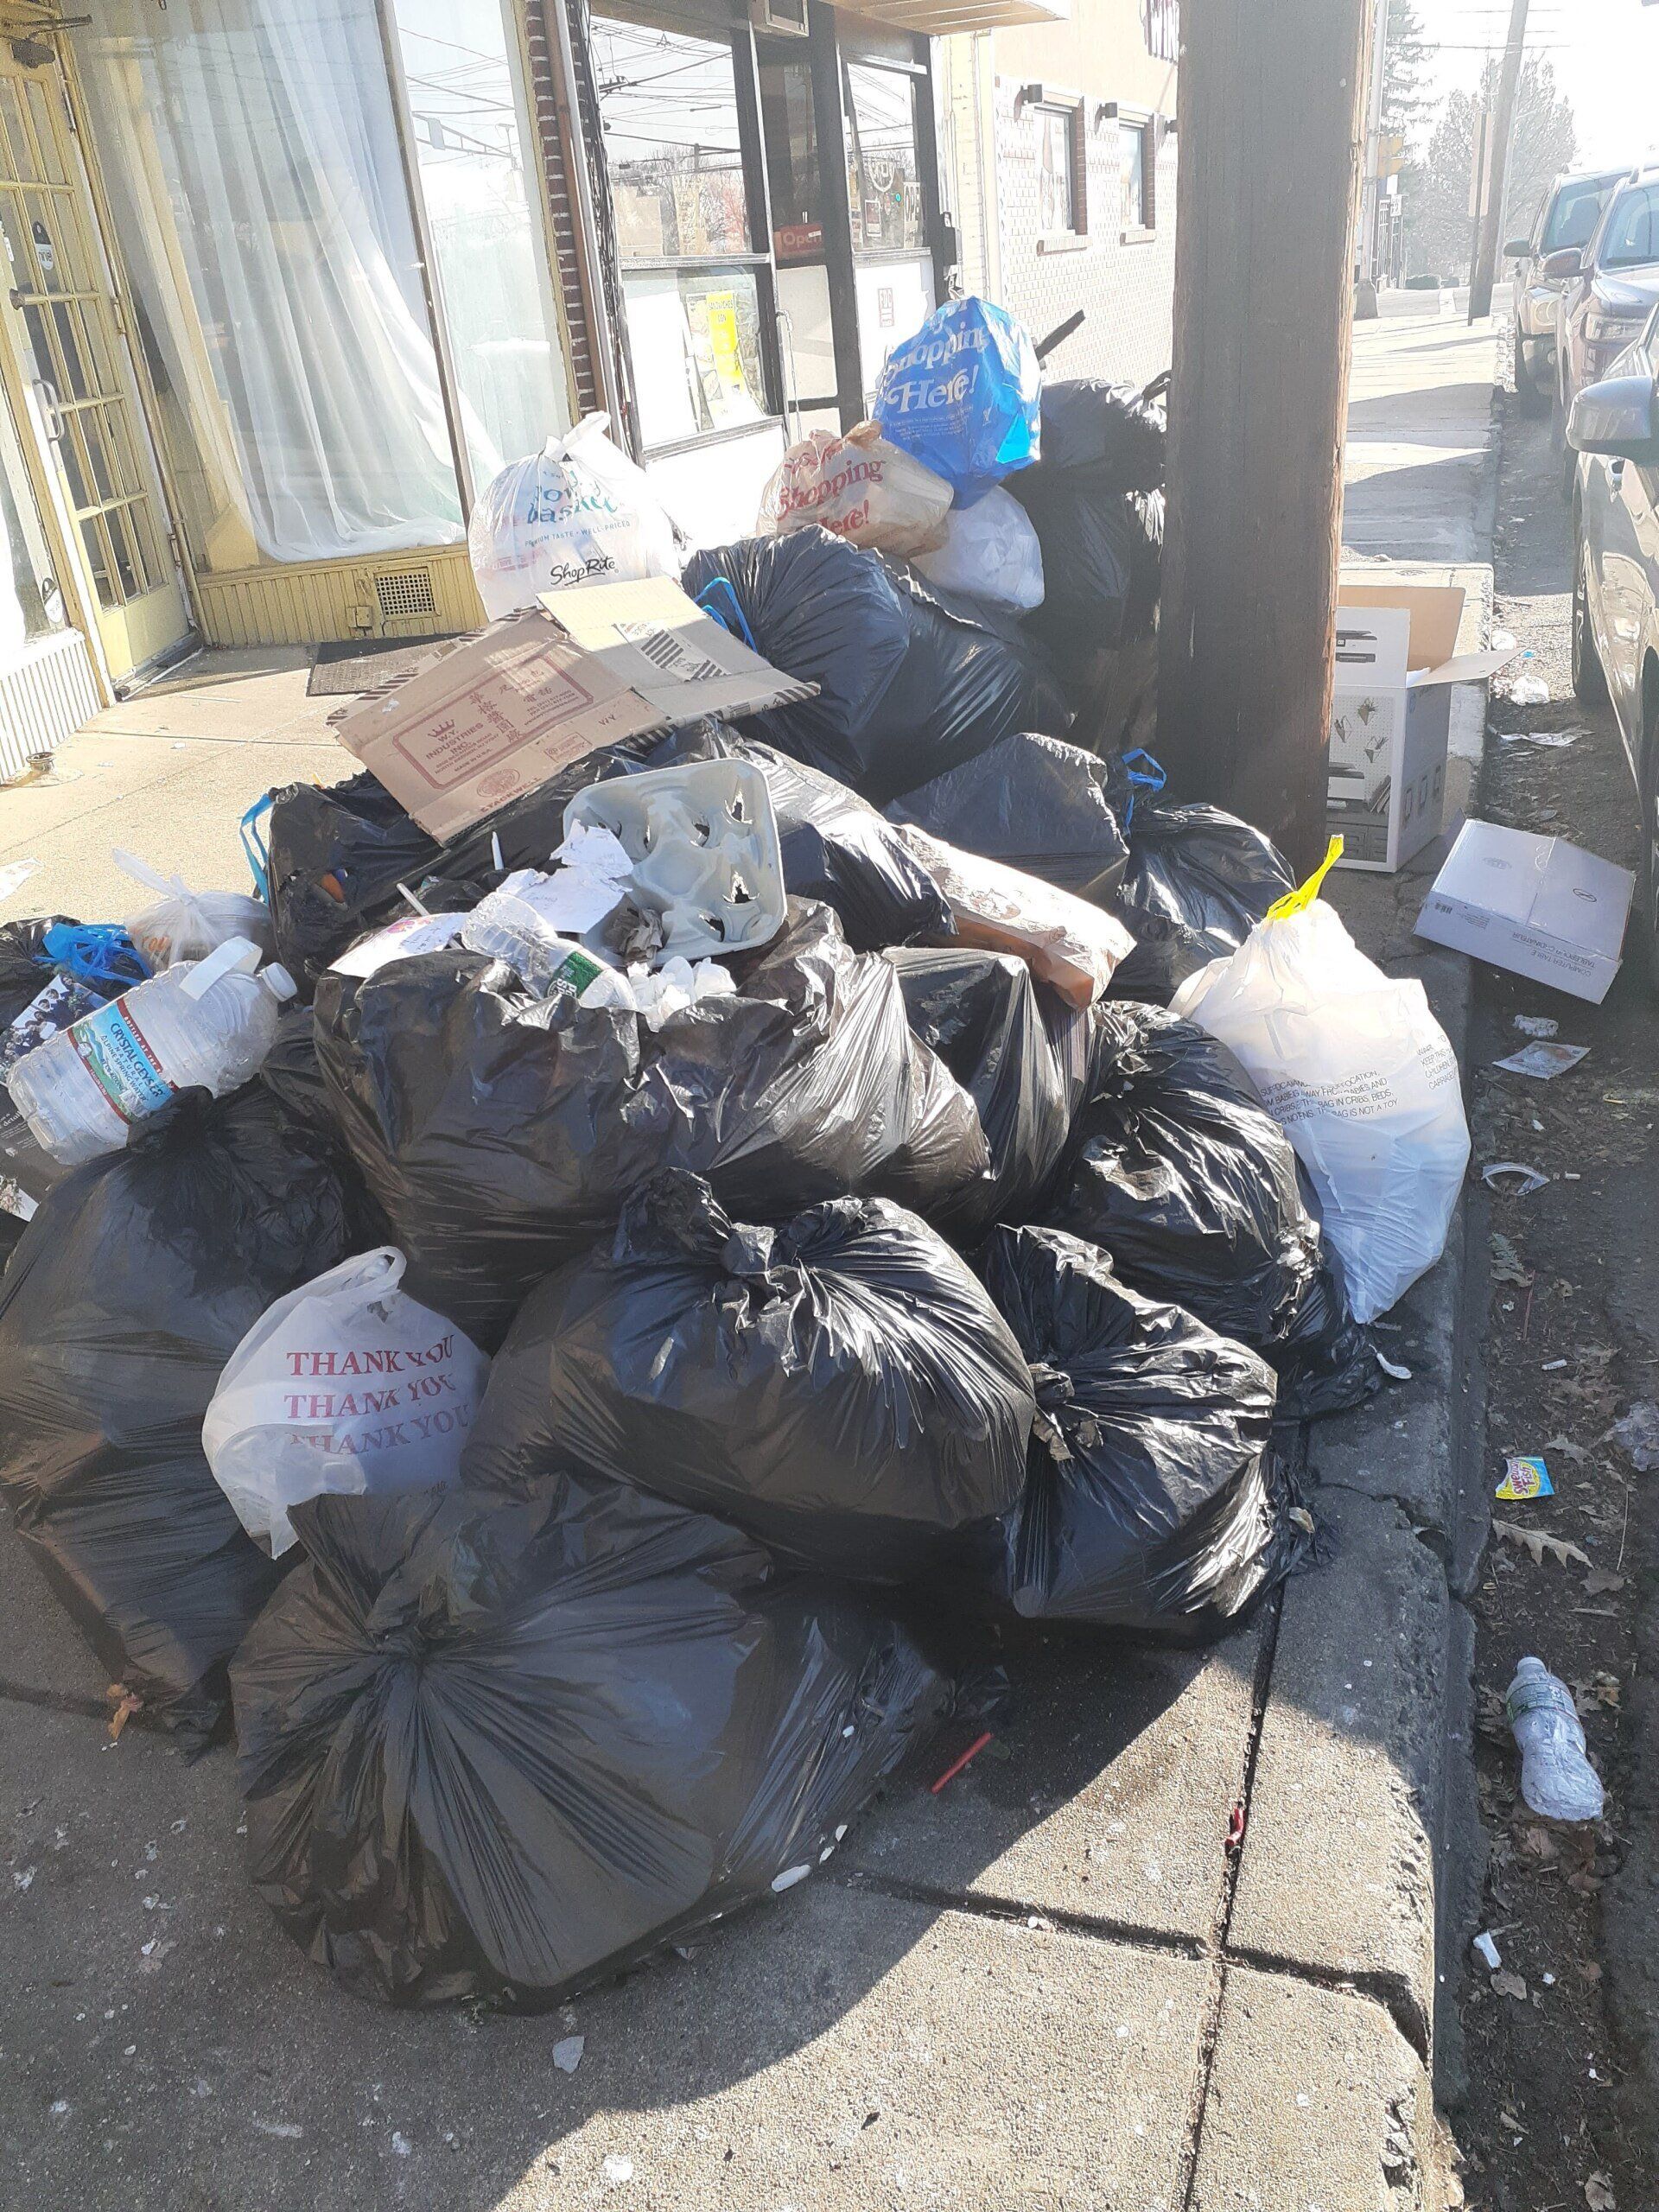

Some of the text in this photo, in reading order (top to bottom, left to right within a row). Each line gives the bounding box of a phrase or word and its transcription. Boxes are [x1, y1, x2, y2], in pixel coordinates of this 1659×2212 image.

[884, 363, 980, 413] Here!
[777, 459, 887, 521] Shopping
[552, 531, 575, 540] TASTE
[581, 520, 631, 536] WELL-PRICED
[550, 556, 616, 586] ShopRite
[425, 721, 484, 759] INDUSTRIES
[437, 728, 459, 742] W.Y.
[449, 739, 472, 753] INC.
[1552, 957, 1592, 977] COMPUTER
[99, 1033, 147, 1103] ALPINE SPRING WATER
[110, 1022, 163, 1097] CRYSTAL GEYSER
[114, 1046, 143, 1086] NATURAL
[1370, 1077, 1388, 1089] AND
[1358, 1105, 1375, 1116] NOT
[1382, 1098, 1398, 1109] TOY
[286, 1335, 455, 1376] THANK YOU
[283, 1374, 457, 1420] THANK YOU
[411, 1403, 471, 1440] YOU
